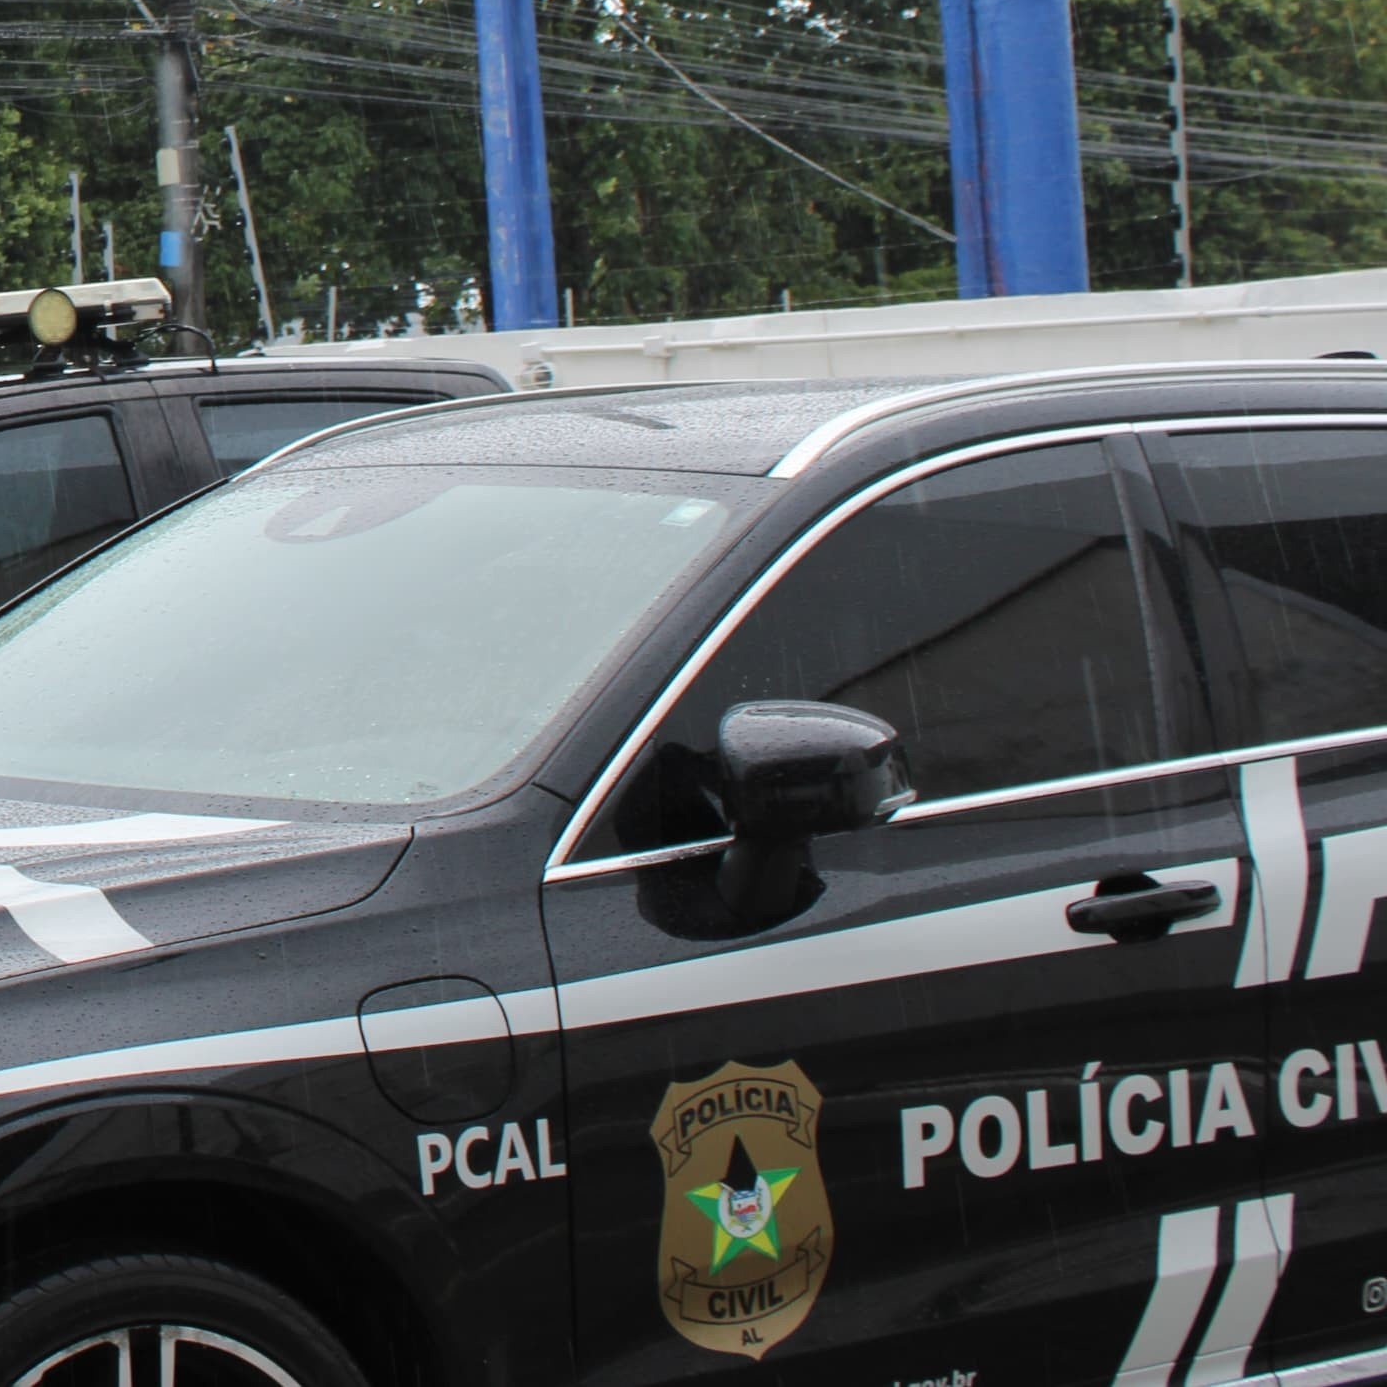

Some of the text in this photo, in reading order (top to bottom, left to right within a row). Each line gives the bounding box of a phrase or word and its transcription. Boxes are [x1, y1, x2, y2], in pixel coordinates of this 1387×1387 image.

[679, 1082, 795, 1138] POLÍCIA
[900, 1060, 1257, 1189] POLÍCIA
[416, 1117, 568, 1197] PCAL
[708, 1280, 783, 1319] CIVIL
[741, 1326, 764, 1346] AL
